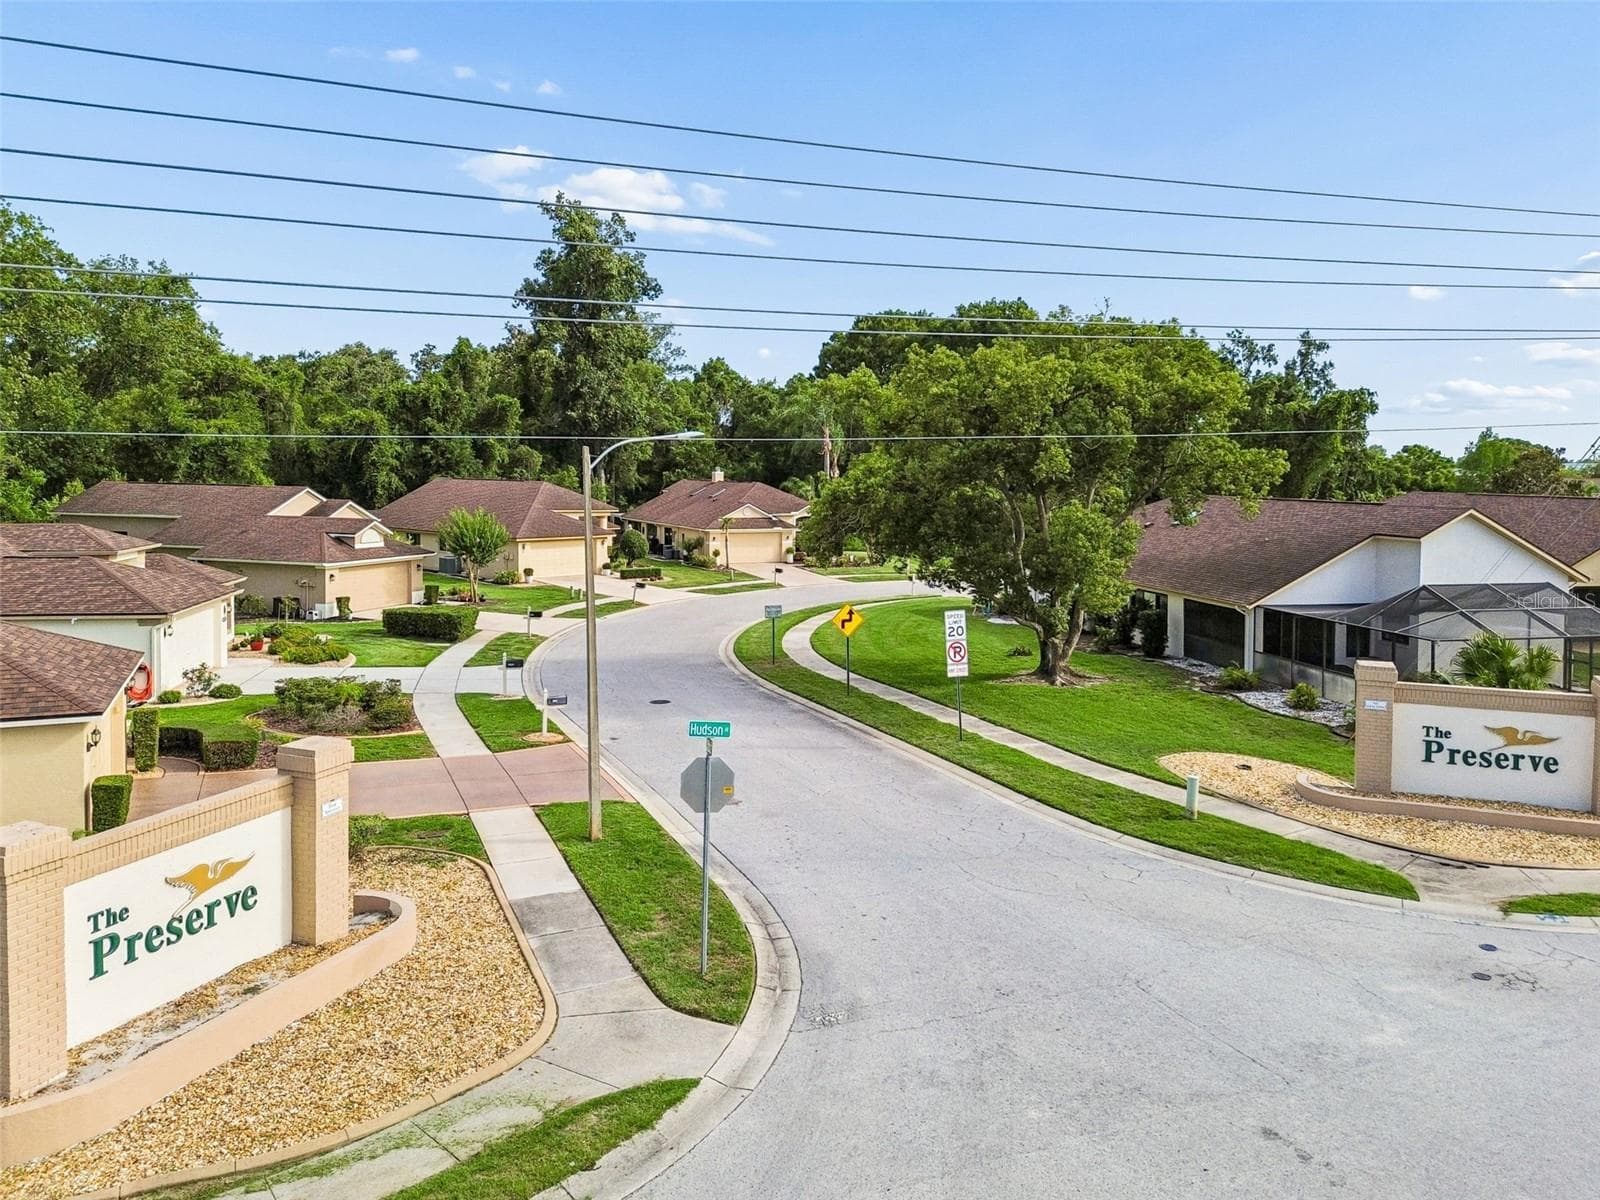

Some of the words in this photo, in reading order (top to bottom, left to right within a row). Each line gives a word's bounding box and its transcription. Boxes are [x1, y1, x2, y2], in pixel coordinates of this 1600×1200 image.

[947, 625, 965, 637] 20
[690, 723, 724, 736] Hudson
[1422, 725, 1452, 739] The
[1421, 739, 1559, 774] Preserve
[87, 906, 130, 934] The
[88, 885, 258, 981] Preserve
